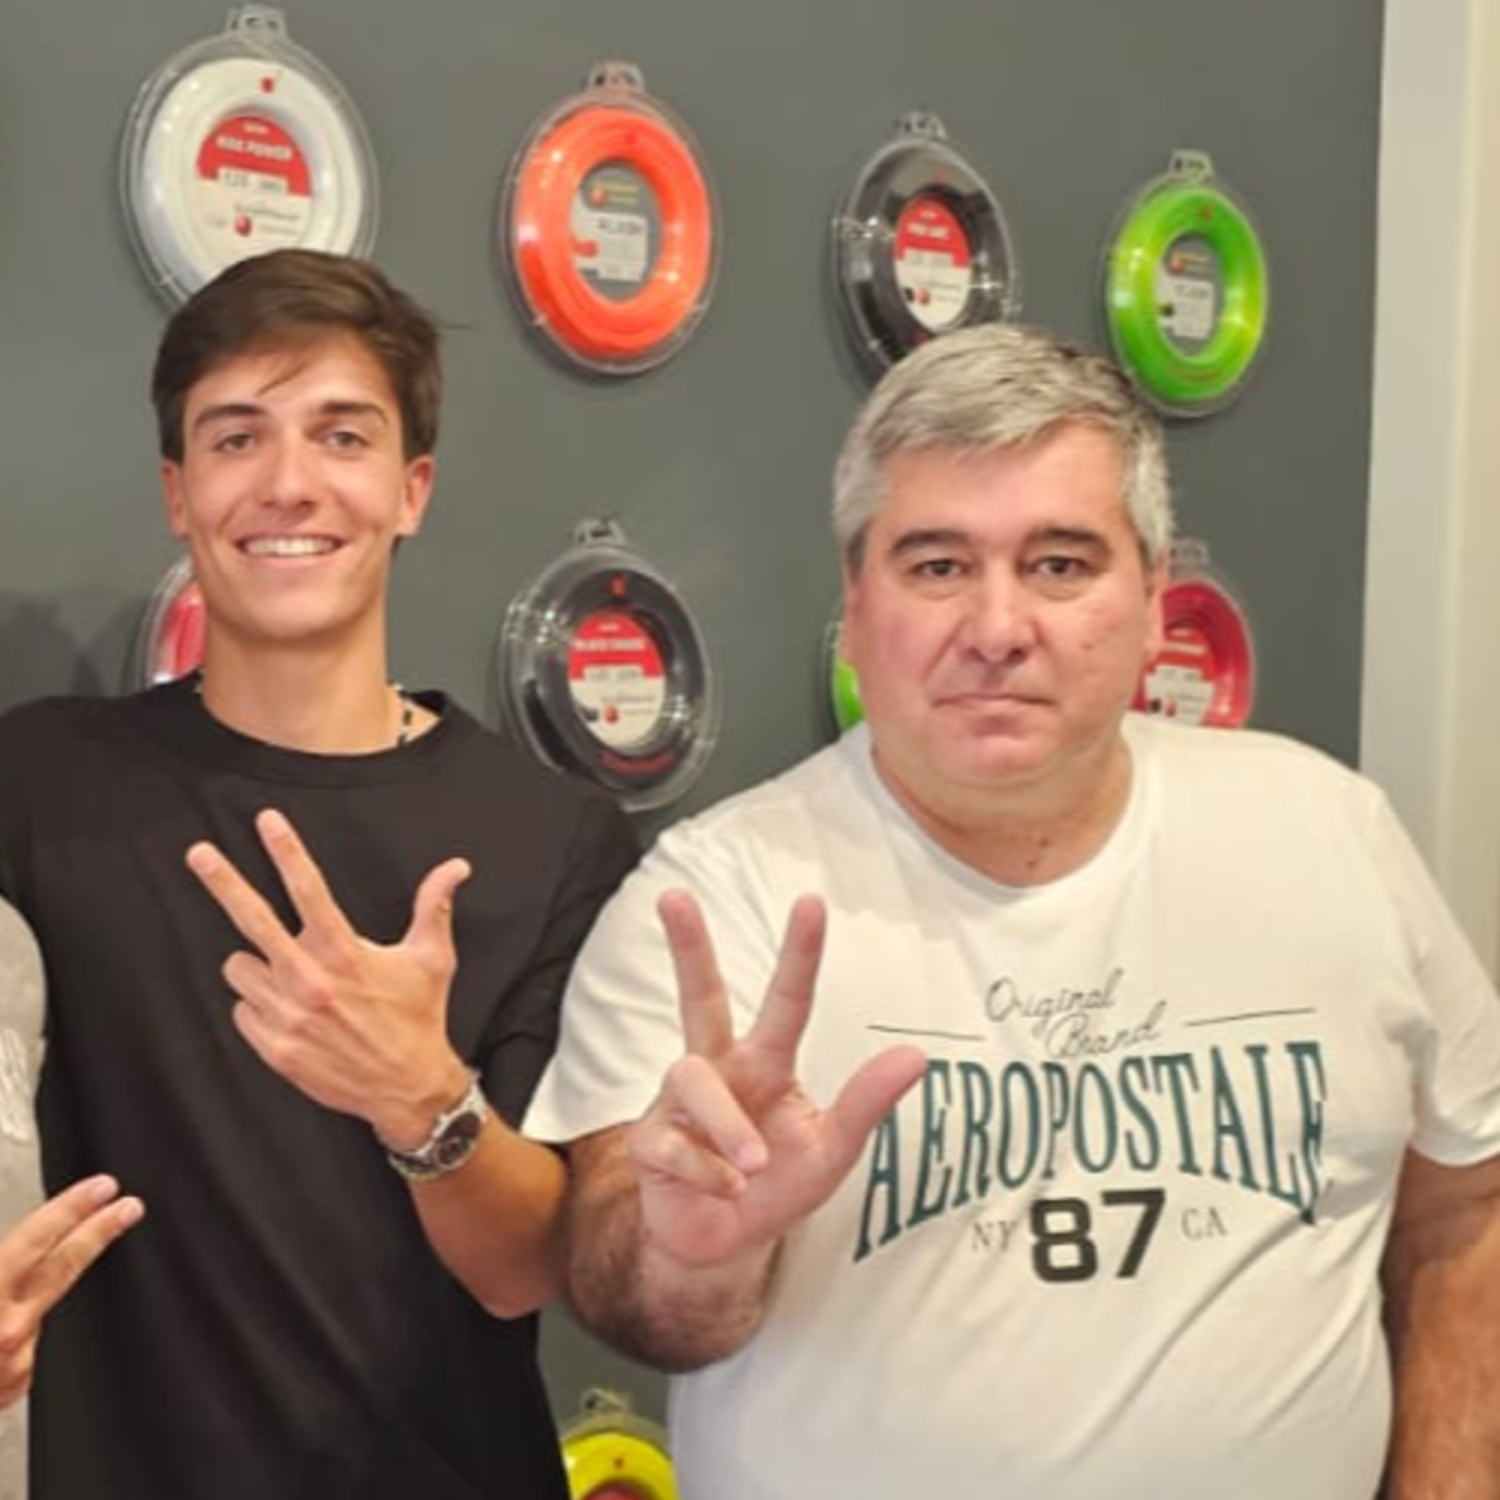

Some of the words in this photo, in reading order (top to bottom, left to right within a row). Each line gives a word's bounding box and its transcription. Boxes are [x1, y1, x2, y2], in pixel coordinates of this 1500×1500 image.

[985, 967, 1124, 1039] Original
[1045, 999, 1168, 1060] Brand
[852, 1041, 1329, 1265] AEROPOSTALE
[971, 1219, 1017, 1252] NY
[1029, 1187, 1167, 1284] 87
[1181, 1205, 1229, 1241] CA
